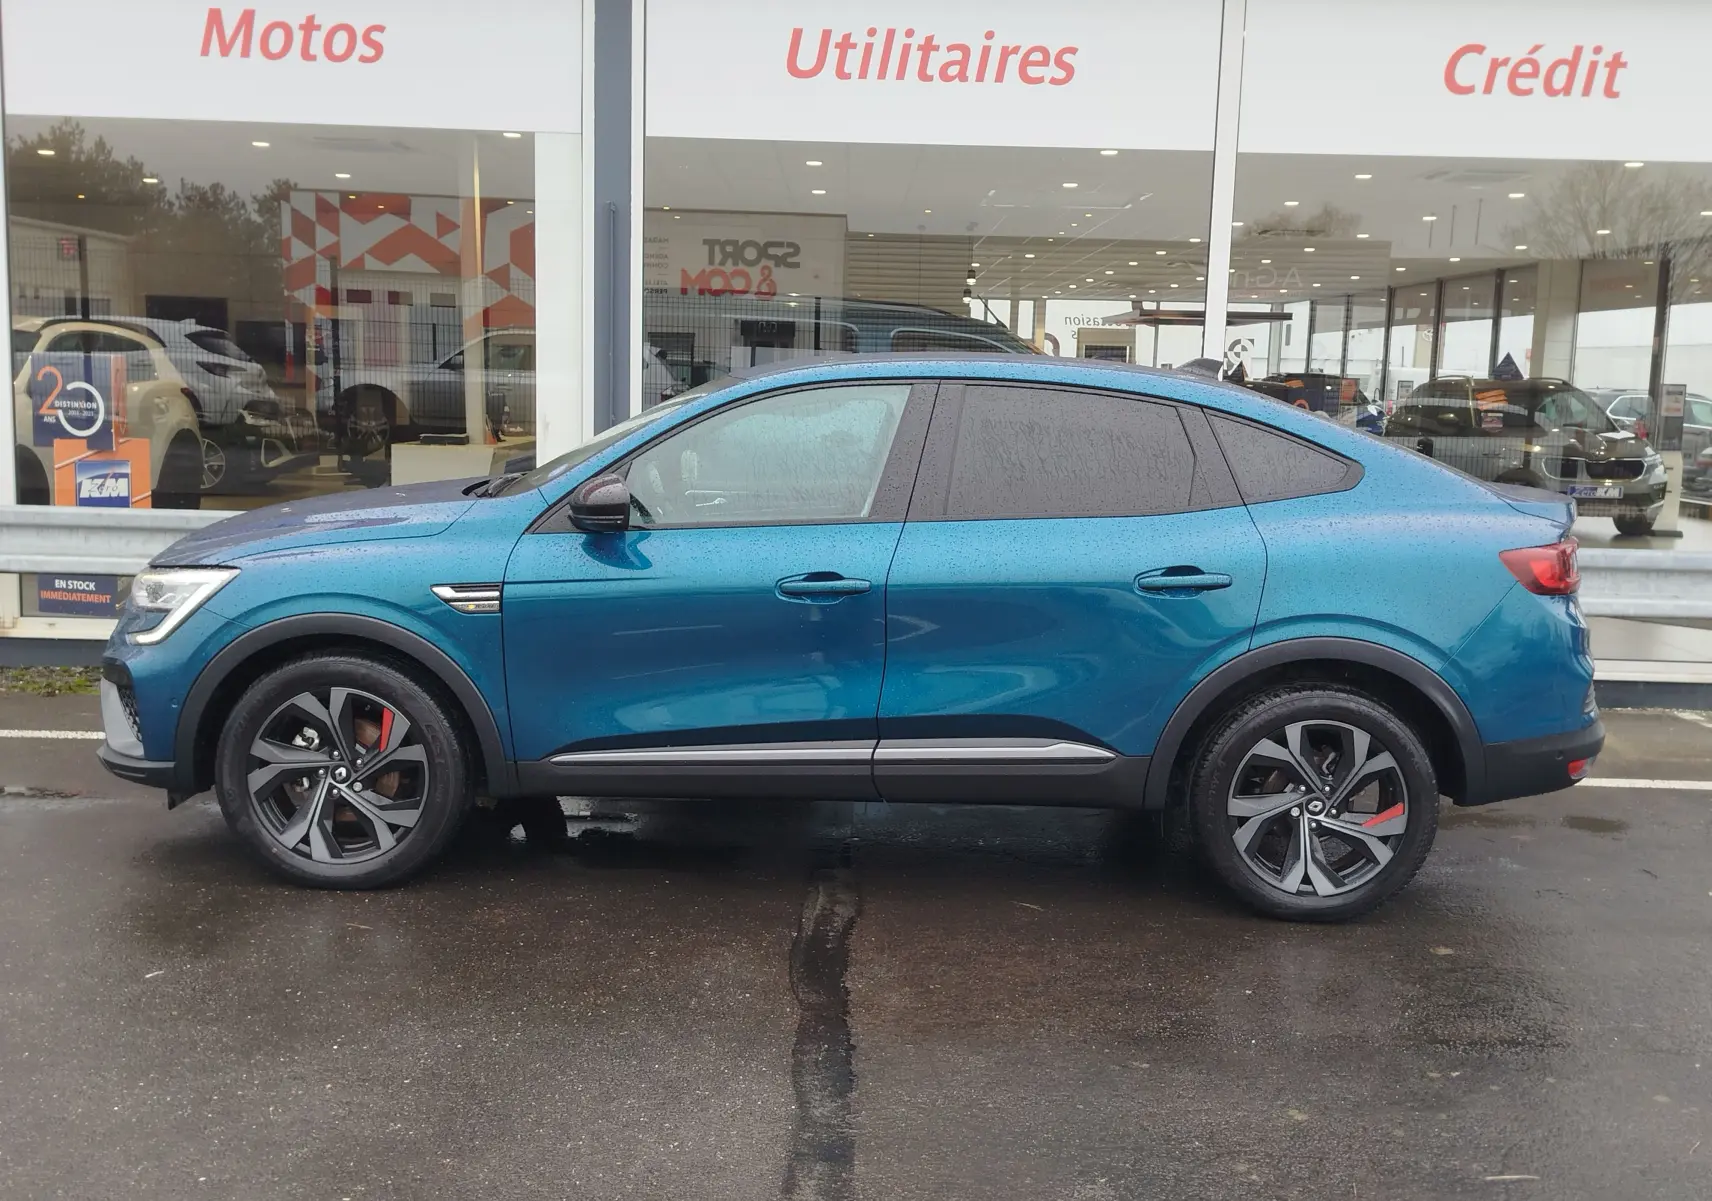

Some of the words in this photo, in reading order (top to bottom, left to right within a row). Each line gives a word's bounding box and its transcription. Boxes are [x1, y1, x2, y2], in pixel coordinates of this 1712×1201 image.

[200, 7, 385, 63] Motos
[786, 28, 1077, 85] Utilitaires
[1444, 43, 1627, 97] Crédit
[43, 415, 57, 423] ANS
[40, 589, 111, 603] IMMÉDIATEMENT
[54, 578, 67, 589] EN
[67, 579, 96, 591] STOCK
